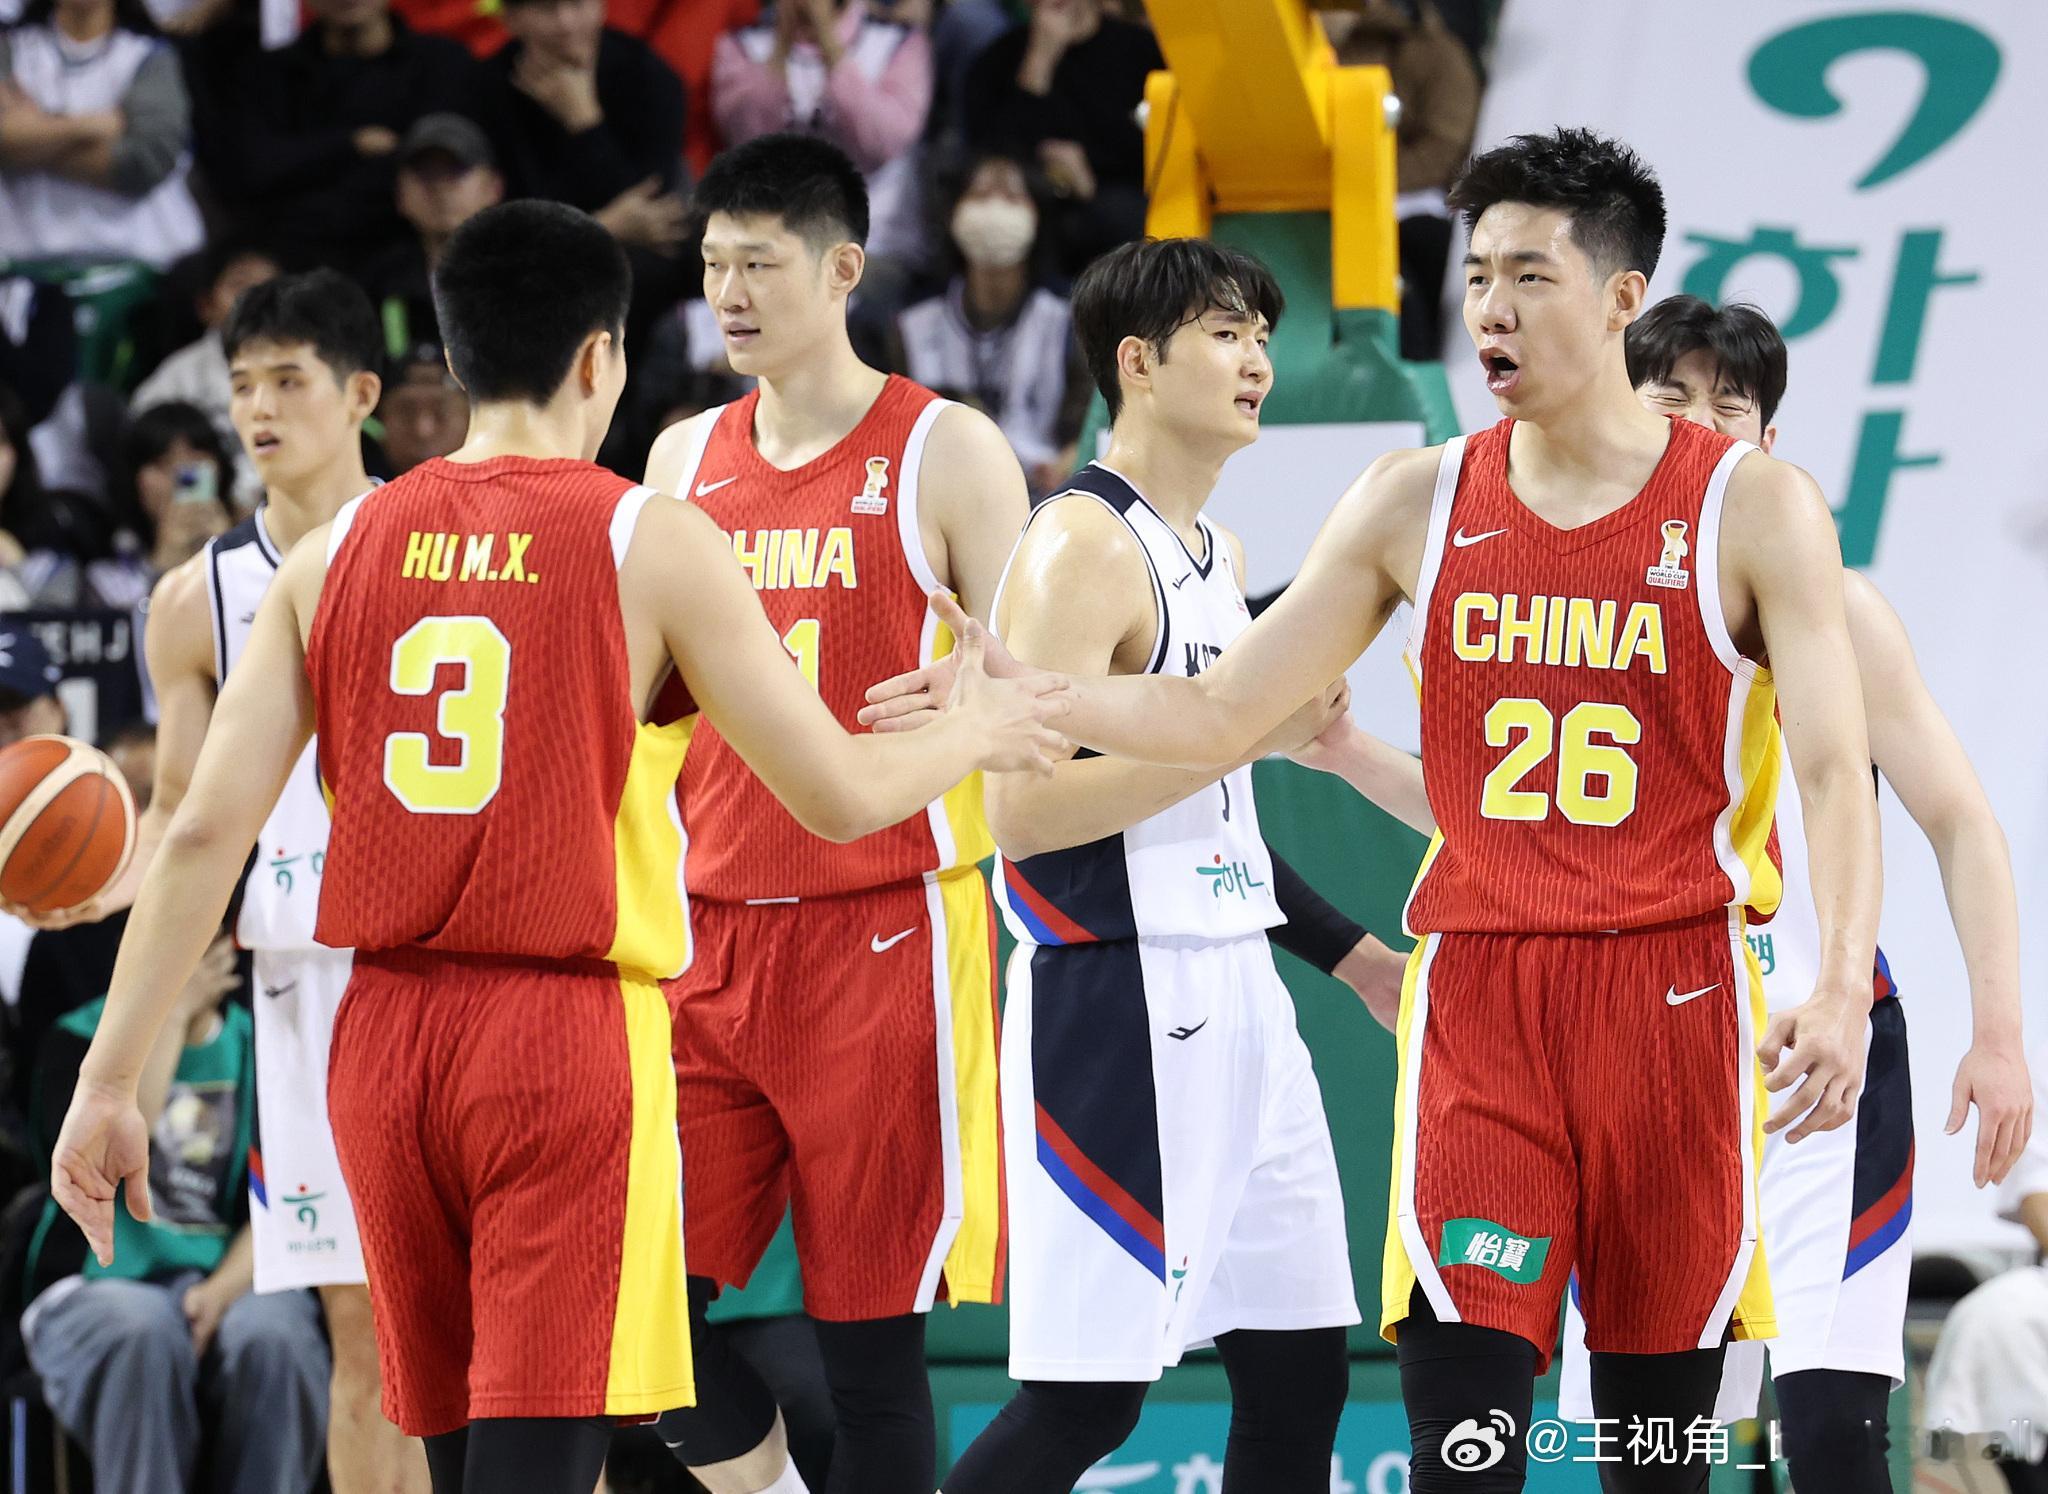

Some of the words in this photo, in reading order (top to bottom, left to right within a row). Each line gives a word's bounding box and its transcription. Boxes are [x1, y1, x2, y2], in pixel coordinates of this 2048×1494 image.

[401, 531, 460, 582] HU
[458, 532, 540, 584] M.X.
[726, 527, 858, 590] HINA
[1648, 576, 1685, 587] QUALIFIERS
[1453, 592, 1668, 675] CHINA
[382, 615, 511, 814] 3
[1480, 697, 1642, 828] 26
[1464, 1231, 1531, 1272] 怡寶
